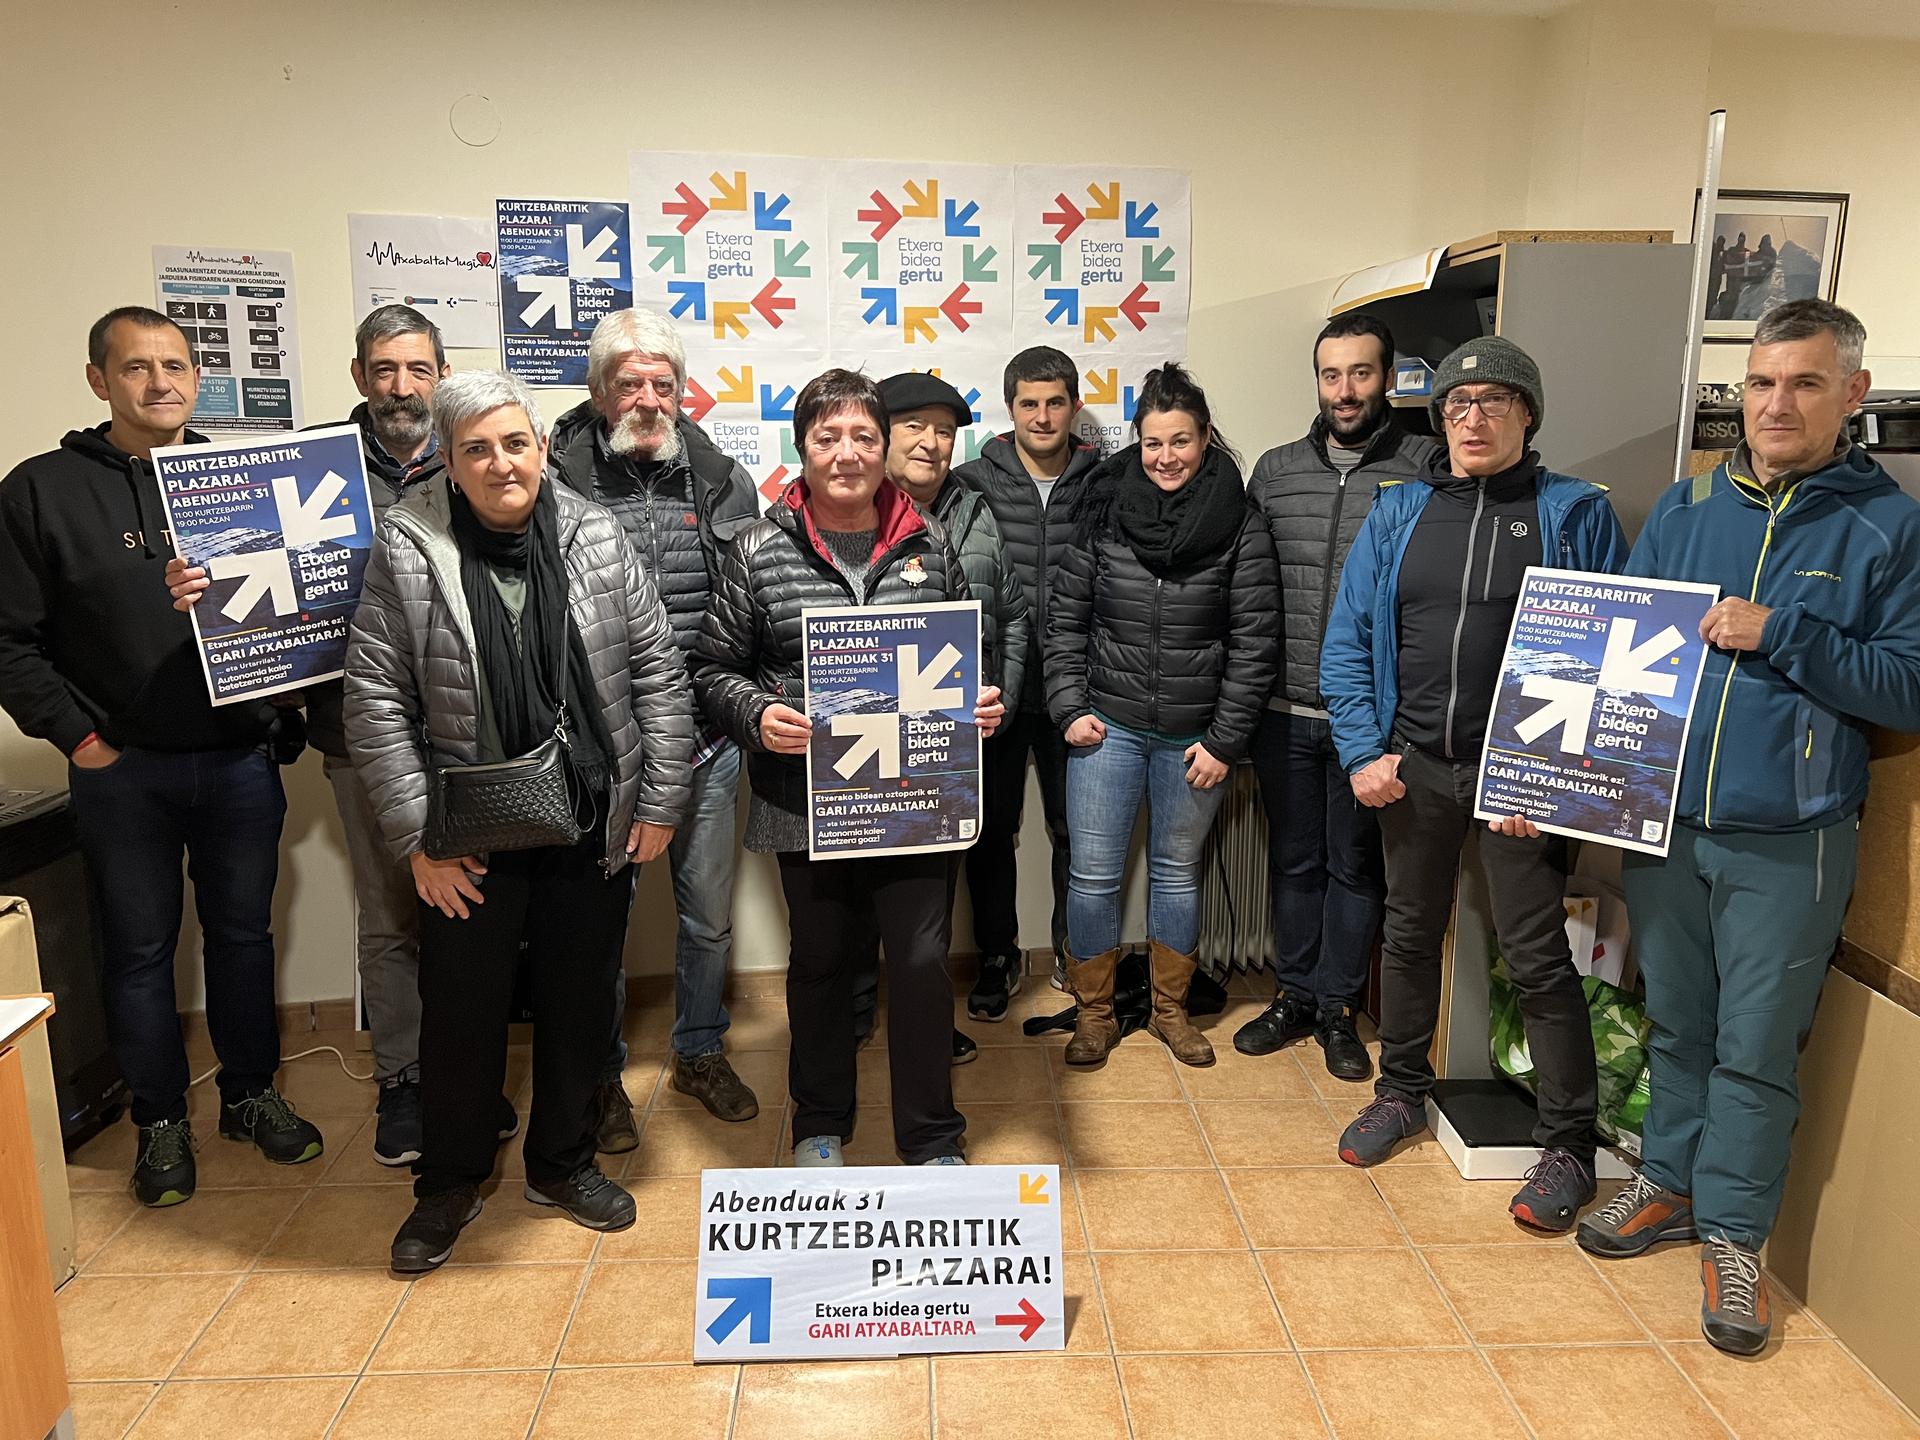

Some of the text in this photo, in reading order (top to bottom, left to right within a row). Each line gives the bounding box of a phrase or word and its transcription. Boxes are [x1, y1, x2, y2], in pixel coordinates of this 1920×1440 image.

[498, 202, 589, 213] KURTZEBARRITIK
[499, 215, 552, 224] PLAZARA!
[500, 228, 563, 237] ABENDUAK 31
[706, 231, 752, 246] Etxera
[899, 237, 943, 251] Etxera
[1081, 239, 1123, 253] Etxera
[709, 245, 751, 261] bidea
[901, 252, 941, 266] bidea
[1083, 253, 1121, 267] bidea
[707, 262, 753, 279] gertu
[899, 268, 943, 285] gertu
[1081, 268, 1122, 286] gertu
[576, 284, 614, 296] Etxera
[576, 297, 610, 308] bidea
[507, 348, 591, 357] GARI ATXABALTA
[713, 422, 759, 436] Etxera
[1081, 423, 1121, 436] Etxera
[716, 436, 758, 450] bidea
[162, 447, 303, 474] KURTZEBARRITIK
[166, 472, 250, 493] PLAZARA!
[172, 487, 269, 508] ABENDUAK 31
[194, 504, 254, 517] KURTZEBARRIN
[199, 516, 231, 525] PLAZAN
[297, 548, 352, 569] Etxera
[300, 564, 349, 583] bidea
[304, 580, 349, 600] gertu
[1528, 580, 1654, 605] KURTZEBARRITIK
[1524, 596, 1596, 616] PLAZARA!
[809, 617, 927, 634] KURTZEBARRITIK
[1520, 612, 1607, 633] ABENDUAK 31
[207, 616, 345, 650] Etxerako bidean oztoporik ez!
[1534, 627, 1587, 640] KURTZEBARRIN
[1534, 636, 1562, 646] PLAZAN
[210, 627, 346, 664] GARI ATXABALTARA!
[810, 636, 879, 651] PLAZARA!
[239, 658, 276, 670] Urtarrilak
[810, 653, 893, 666] ABENDUAK 31
[217, 663, 293, 685] Autonomia kalea
[827, 667, 878, 675] KURTZEBARRIN
[219, 671, 288, 693] betetzera goaz!
[830, 676, 857, 684] PLAZAN
[1601, 697, 1658, 720] Etxera
[907, 720, 955, 734] Etxera
[1598, 713, 1648, 736] bidea
[908, 734, 950, 749] bidea
[1594, 733, 1642, 752] gertu
[907, 750, 948, 767] gertu
[1489, 752, 1625, 785] Etxerako bidean oztoporik ez!
[1487, 765, 1623, 800] GARI ATXABALTARA!
[1496, 783, 1508, 791] eta
[1510, 785, 1545, 798] Urtarrilak
[815, 787, 940, 803] Etxerako bidean oztoporik ez!
[1485, 790, 1558, 811] Autonomia kalea
[816, 799, 939, 817] GARI ATXABALTARA!
[1484, 798, 1551, 818] betetzera goaz!
[839, 819, 873, 827] Urtarrilak
[818, 827, 886, 839] Autonomia kalea
[818, 835, 880, 846] betetzera goaz!
[708, 1189, 886, 1213] Abenduak 31
[708, 1218, 1022, 1252] KURTZEBARRITIK
[871, 1256, 1052, 1287] PLAZARA!
[815, 1301, 970, 1320] Etxera bidea gertu
[808, 1320, 976, 1339] GARI ATXABALTARA
